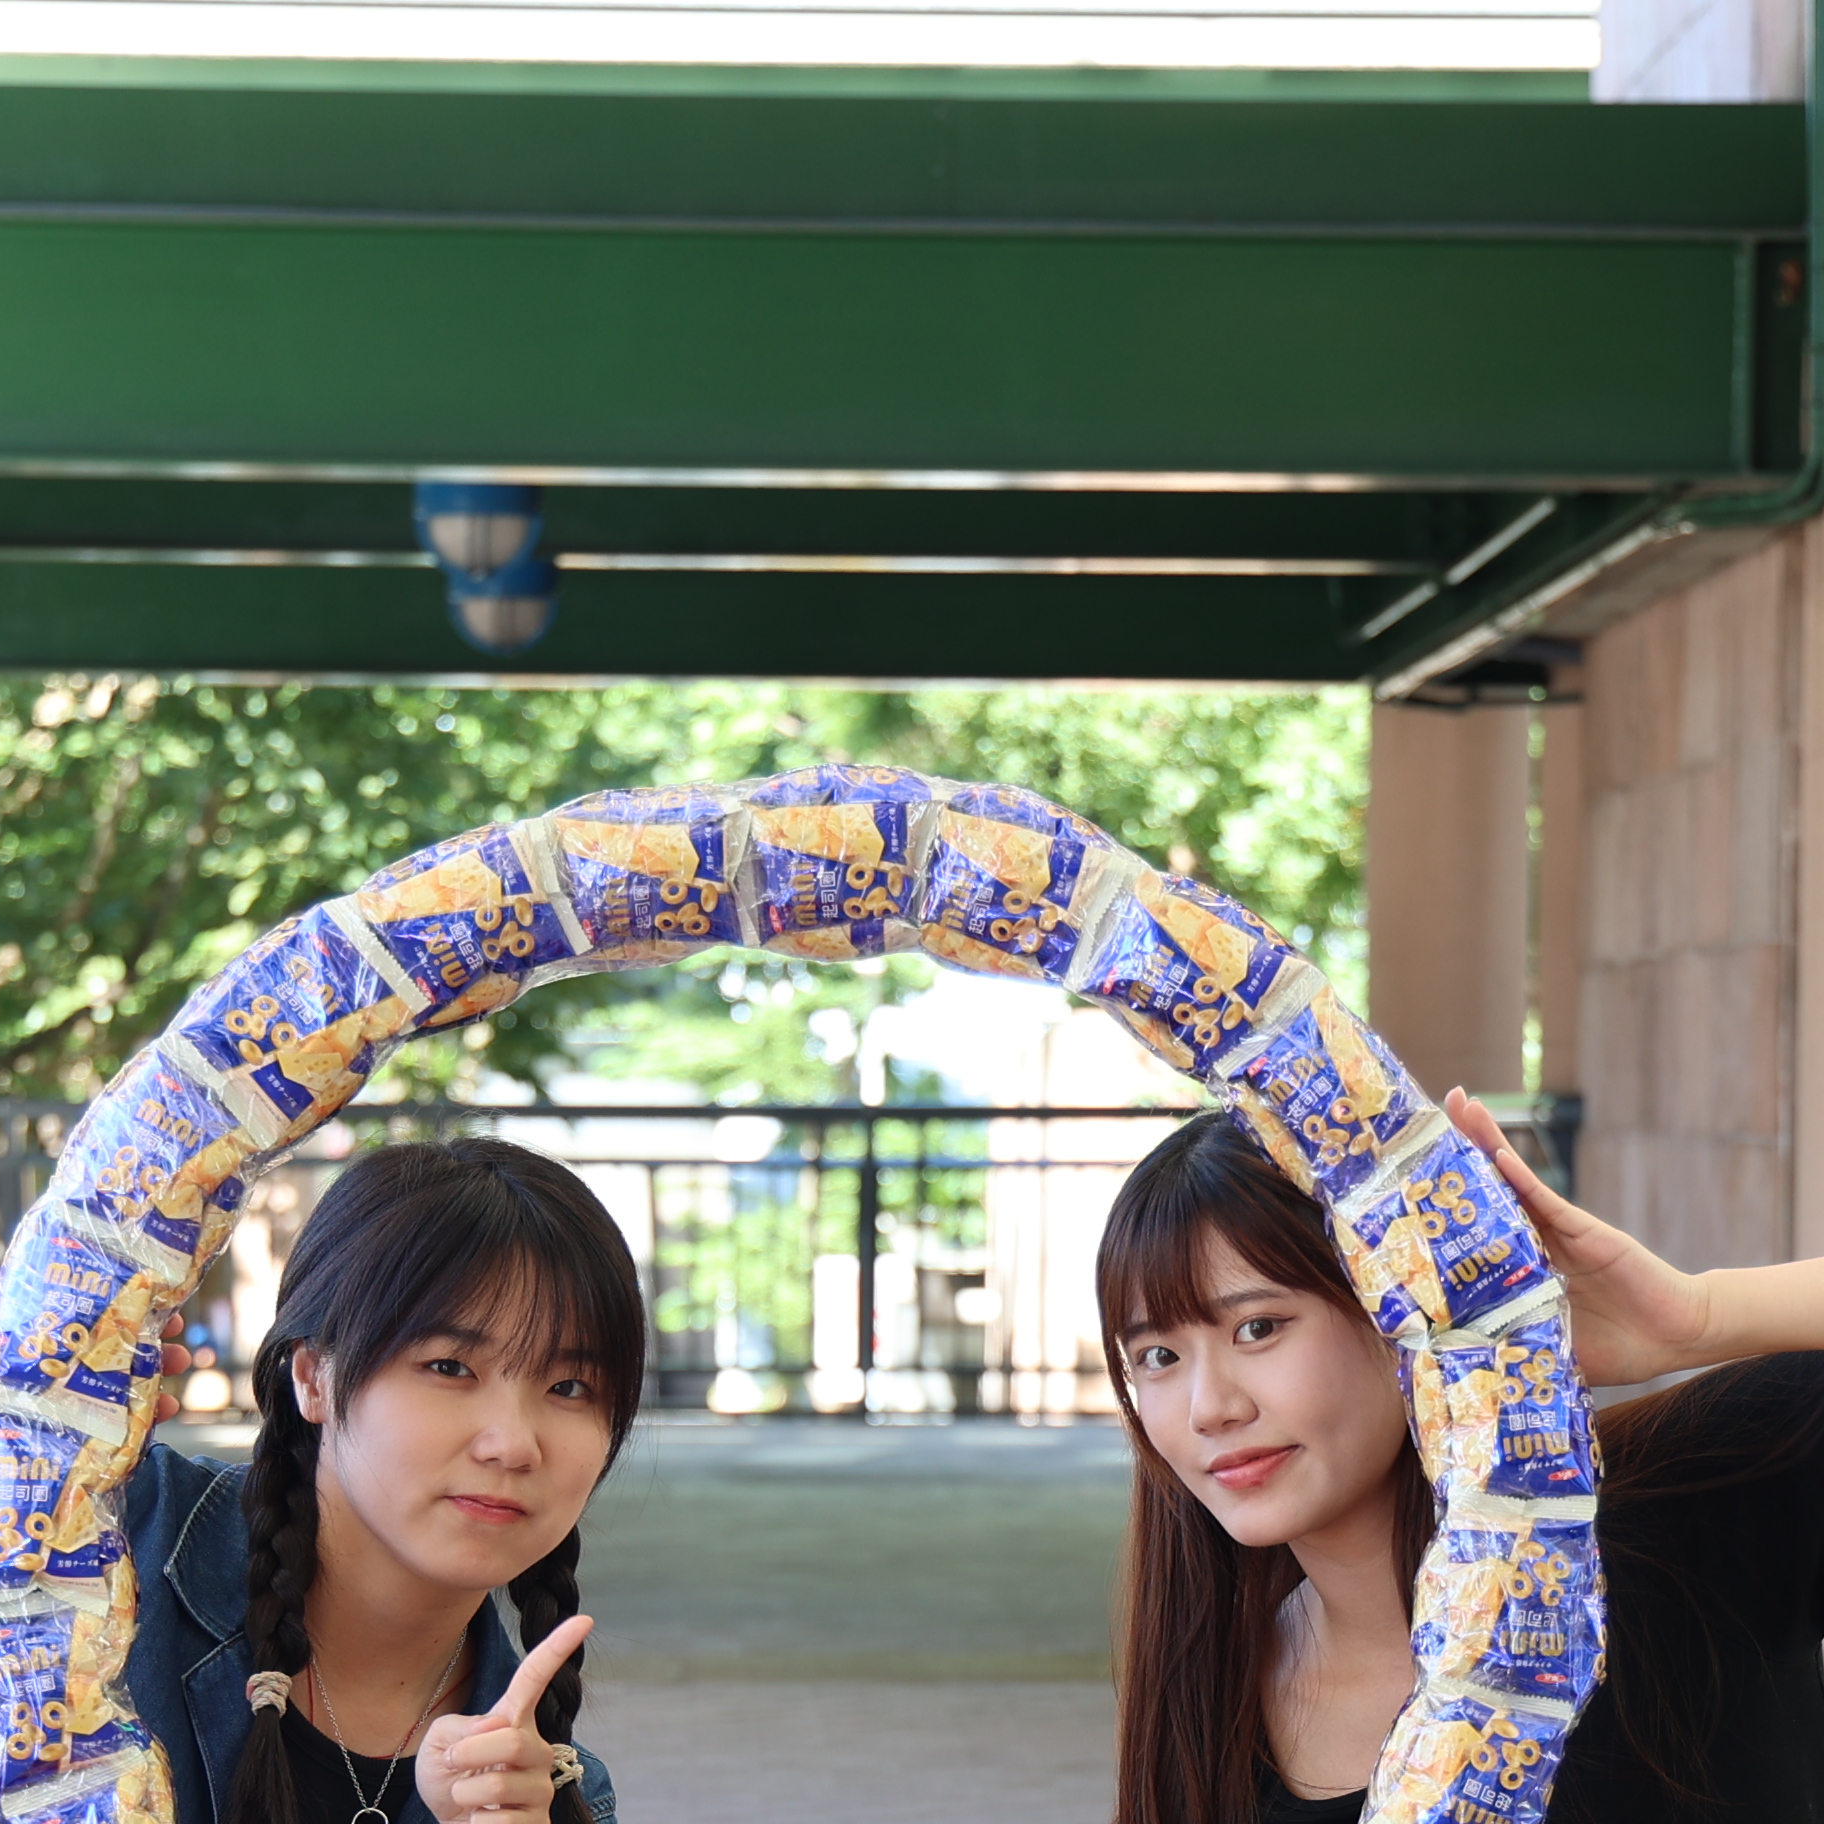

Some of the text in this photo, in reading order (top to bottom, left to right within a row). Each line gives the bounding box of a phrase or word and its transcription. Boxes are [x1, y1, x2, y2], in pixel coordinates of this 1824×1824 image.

[633, 884, 651, 930] 起司圈
[787, 861, 815, 926] mini
[819, 869, 838, 918] 起司圈
[964, 885, 995, 935] 起司圈
[420, 924, 468, 989] mini
[448, 921, 484, 970] 起司圈
[275, 978, 319, 1024] 起司圈
[1148, 963, 1191, 1012] 起司圈
[1264, 1049, 1326, 1103] mini
[1282, 1075, 1333, 1120] 起司圈
[136, 1096, 201, 1149] mini
[1439, 1223, 1490, 1262] 起司圈
[1445, 1237, 1514, 1290] mini
[43, 1260, 112, 1298] mini
[43, 1287, 93, 1313] 起司圈
[1508, 1411, 1557, 1431] 起司圈
[1503, 1431, 1571, 1461] mini
[1462, 1777, 1513, 1811] 起司圈
